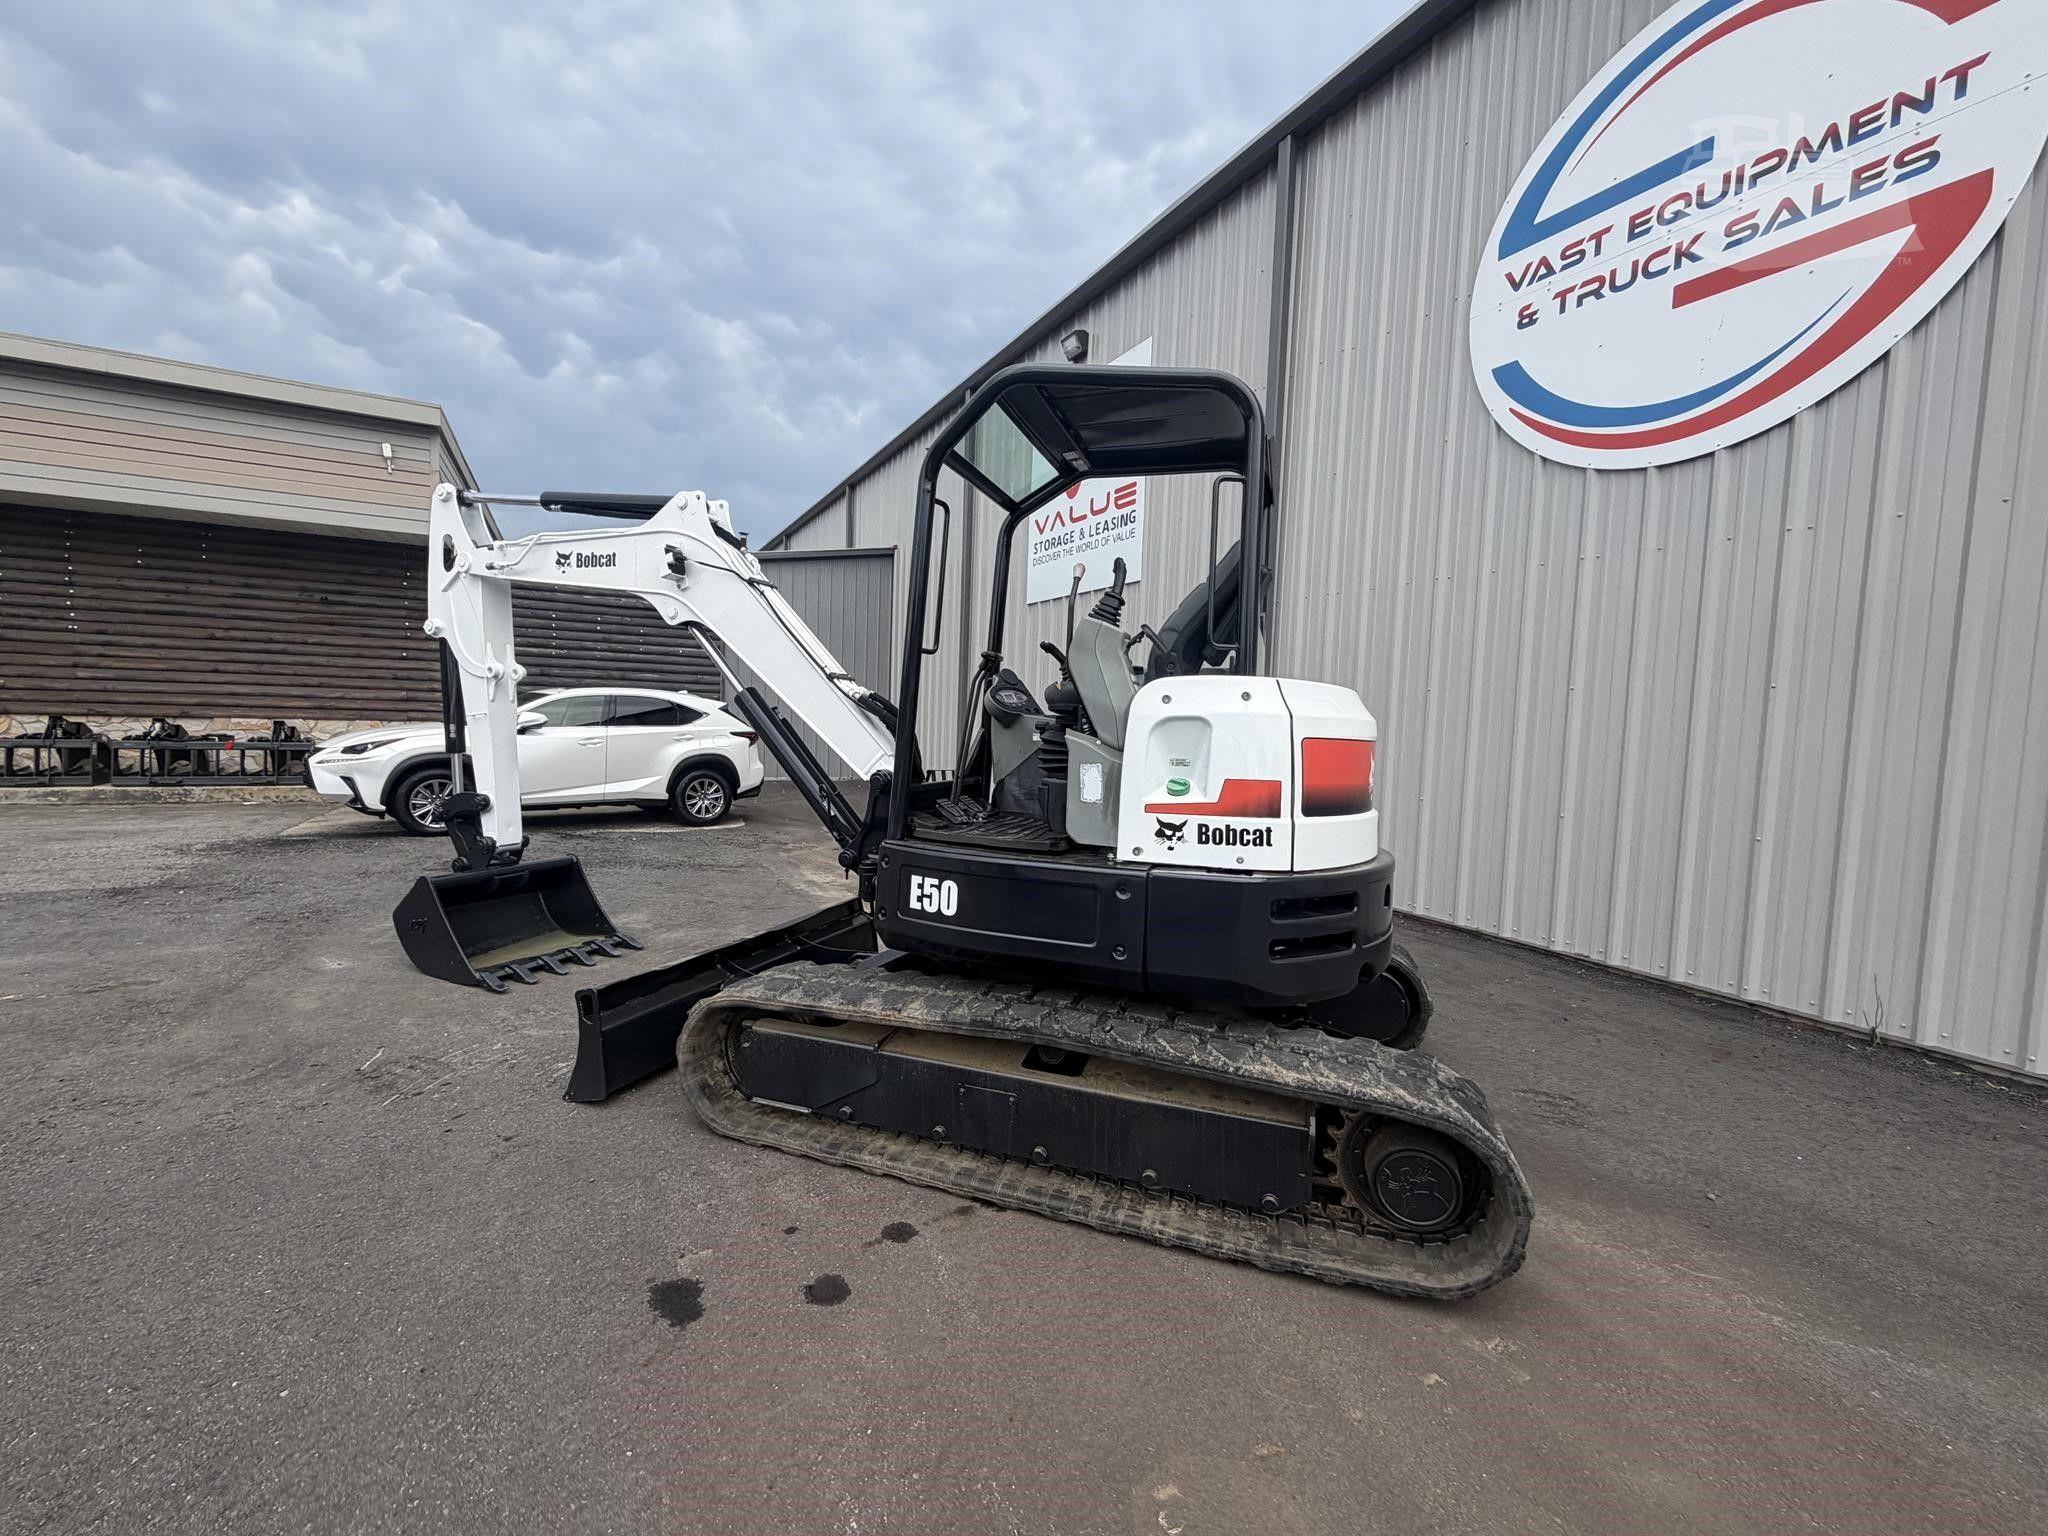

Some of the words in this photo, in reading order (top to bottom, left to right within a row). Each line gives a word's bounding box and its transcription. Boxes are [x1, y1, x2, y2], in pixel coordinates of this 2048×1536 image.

[1504, 224, 1614, 293] VAST
[1627, 51, 1992, 243] EQUIPMENT
[1516, 302, 1539, 330] &
[1552, 231, 1706, 315] TRUCK
[1722, 134, 1942, 252] SALES
[1034, 481, 1137, 535] VALUE
[1032, 550, 1061, 567] DISCOVER
[1062, 545, 1074, 558] THE
[1075, 537, 1099, 552] WORLD
[1101, 535, 1111, 547] OF
[1112, 527, 1136, 544] VALUE
[1033, 530, 1075, 555] STORAGE
[1079, 527, 1085, 541] &
[1088, 509, 1136, 538] LEASING
[576, 552, 617, 568] Bobcat
[1197, 823, 1273, 847] Bobcat
[909, 874, 958, 917] E50
